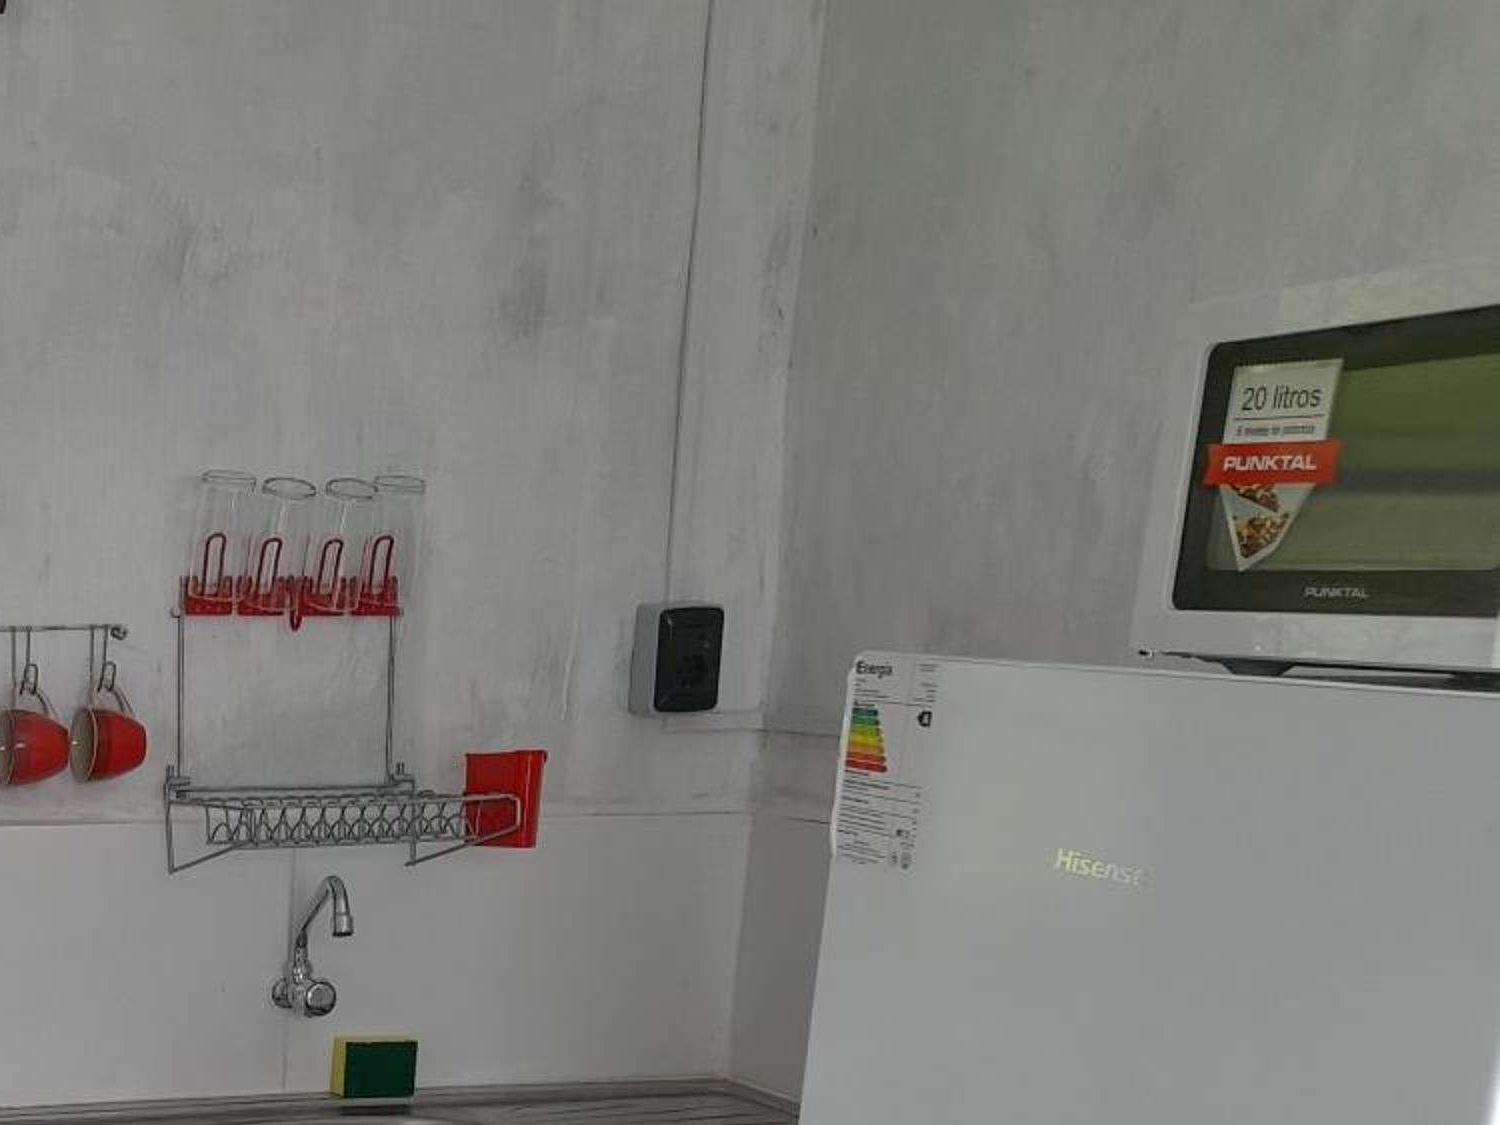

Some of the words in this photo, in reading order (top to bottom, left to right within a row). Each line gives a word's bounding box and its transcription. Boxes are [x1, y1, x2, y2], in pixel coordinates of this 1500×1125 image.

[1241, 386, 1267, 411] 20
[1273, 384, 1322, 410] litros
[1222, 454, 1317, 472] PUNKTAL
[1303, 586, 1369, 599] PUNKTAL
